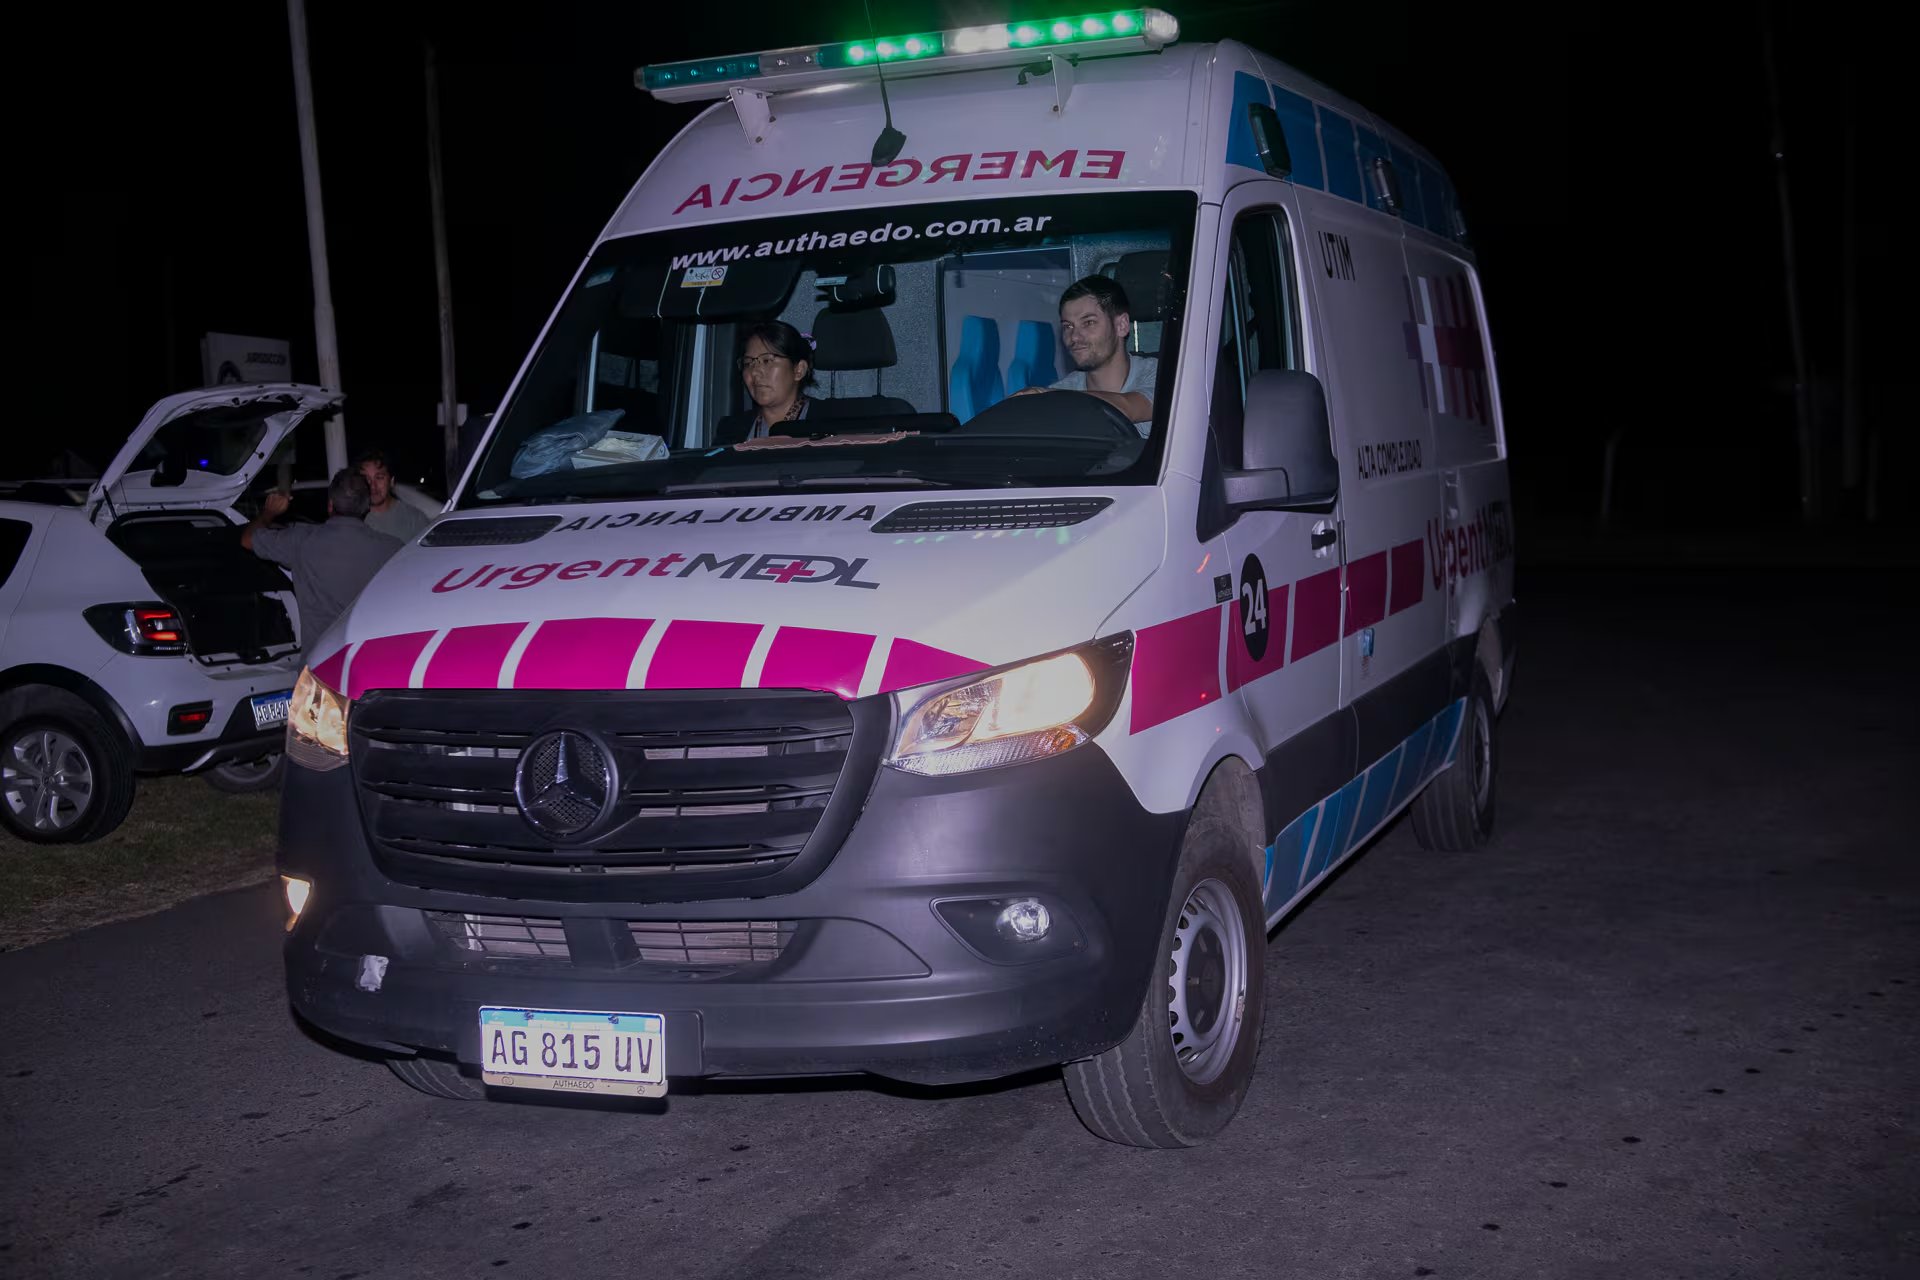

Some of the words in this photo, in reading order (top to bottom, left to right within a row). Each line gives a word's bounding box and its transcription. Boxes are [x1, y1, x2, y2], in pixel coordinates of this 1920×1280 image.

[671, 211, 1052, 271] www.authaedo.com.ar
[1317, 230, 1356, 281] UTIM
[1357, 444, 1377, 480] ALTA
[1241, 578, 1267, 636] 24
[491, 1029, 528, 1066] AG
[541, 1032, 600, 1070] 815
[614, 1036, 653, 1074] UV
[552, 1079, 595, 1090] AUTHAEDO
